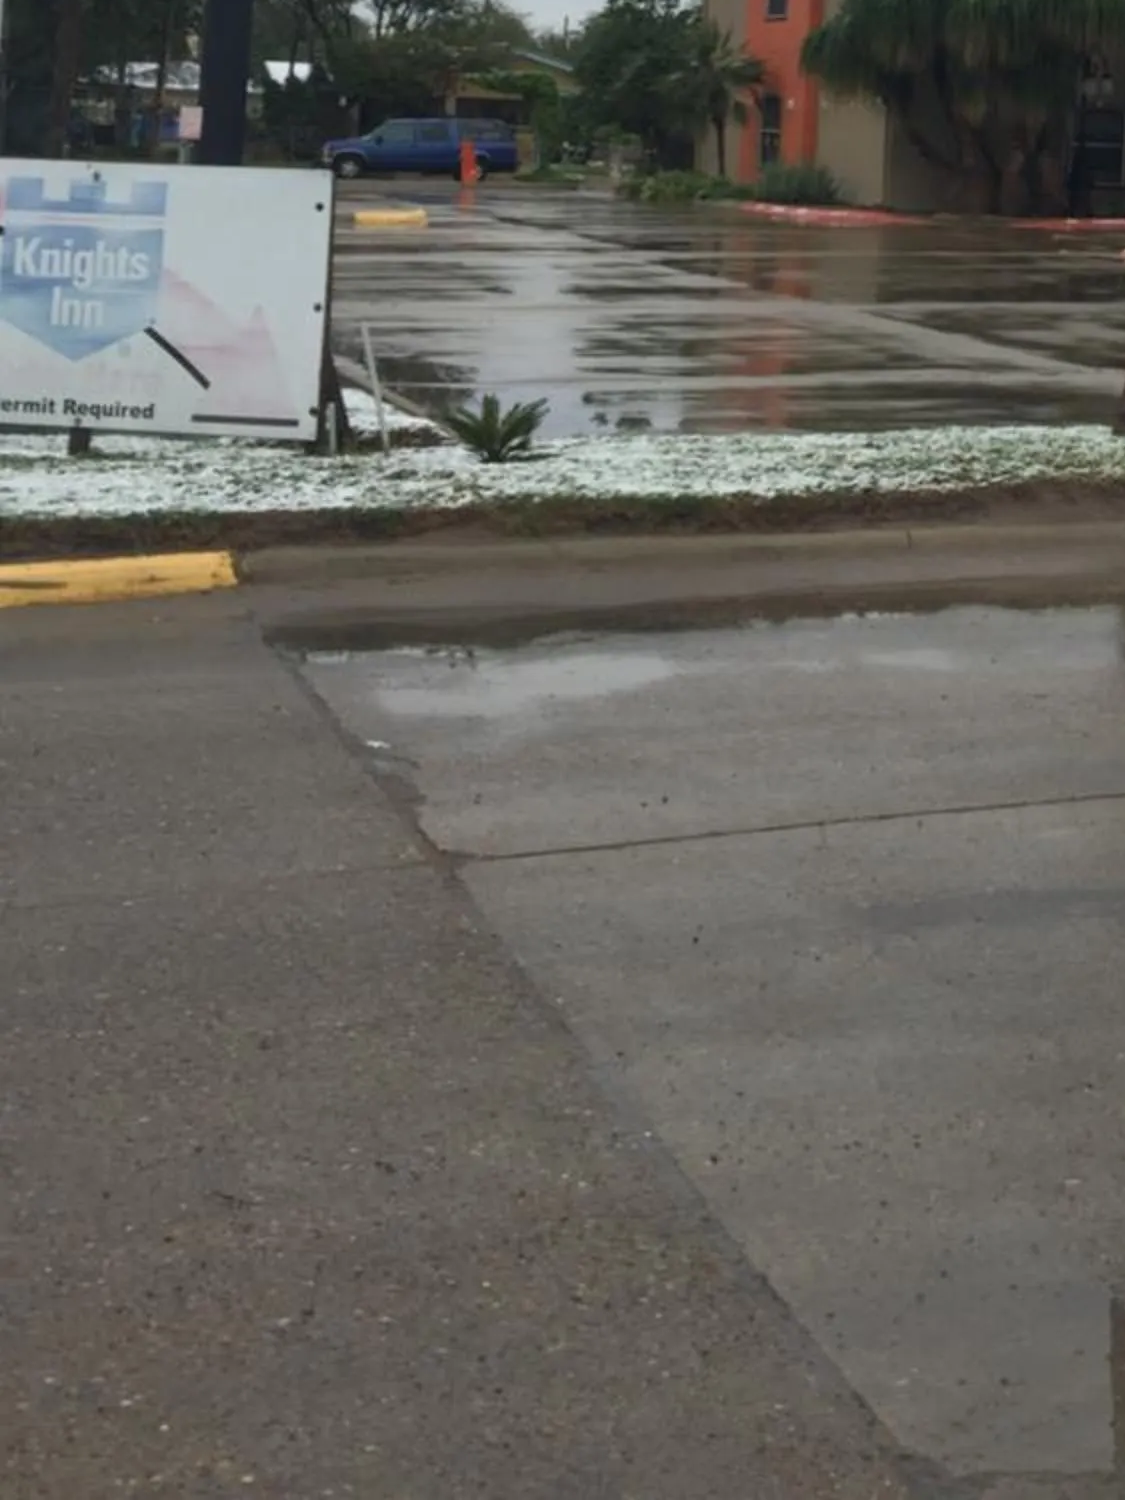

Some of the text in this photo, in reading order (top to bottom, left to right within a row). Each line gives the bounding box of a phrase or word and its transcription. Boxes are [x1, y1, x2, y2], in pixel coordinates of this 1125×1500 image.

[13, 236, 150, 288] Knights
[51, 285, 102, 329] Inn
[0, 396, 156, 420] ermit Required
